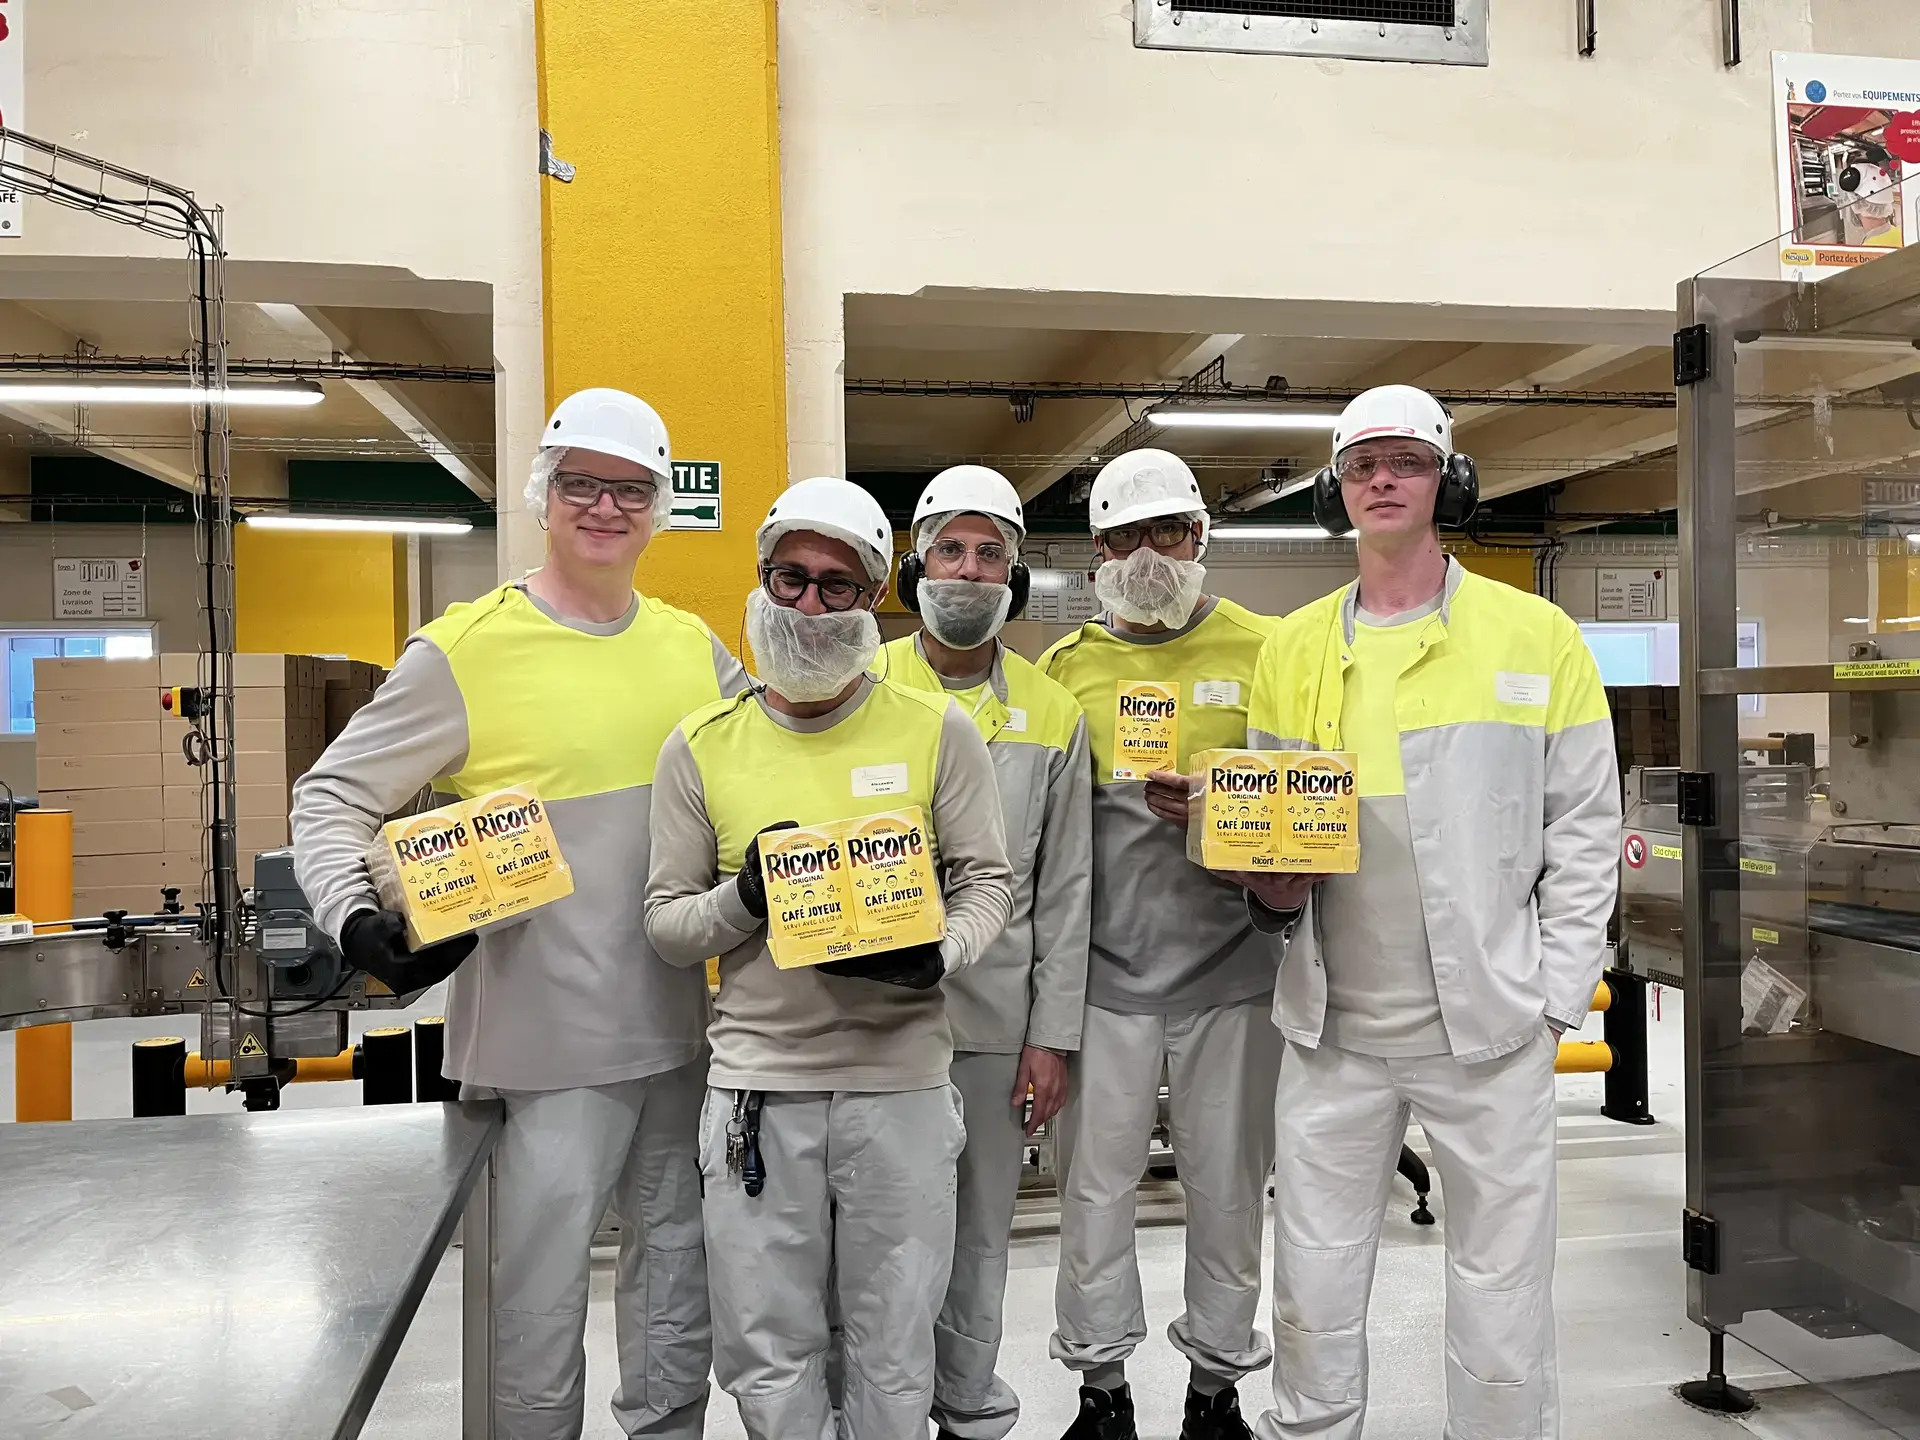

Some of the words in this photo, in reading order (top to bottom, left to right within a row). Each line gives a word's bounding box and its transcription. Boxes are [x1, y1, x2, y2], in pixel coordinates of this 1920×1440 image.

[1833, 90, 1851, 99] Portez
[1863, 90, 1920, 102] EQUIPEMENTS
[1820, 253, 1844, 262] Portez
[1845, 254, 1858, 263] des
[674, 466, 712, 490] TIE
[1120, 696, 1175, 718] Ricoré
[1123, 737, 1141, 747] CAFÉ
[1143, 740, 1168, 748] JOYEUX
[1211, 768, 1277, 794] Ricoré
[1287, 769, 1353, 795] Ricoré
[472, 798, 542, 842] Ricoré
[1217, 817, 1238, 829] CAFÉ
[1240, 820, 1271, 830] JOYEUX
[1293, 819, 1313, 831] CAFÉ
[1316, 823, 1347, 832] JOYEUX
[497, 828, 530, 842] L'ORIGINAL
[394, 821, 469, 866] Ricoré
[848, 827, 922, 868] Ricoré
[1654, 846, 1664, 856] Std
[420, 852, 455, 867] L'ORIGINAL
[496, 857, 518, 875] CAFÉ
[521, 849, 550, 867] JOYEUX
[765, 842, 841, 883] Ricoré
[871, 859, 907, 870] L'ORIGINAL
[1252, 856, 1274, 865] Ricoré
[1742, 860, 1772, 873] relevage
[419, 881, 442, 900] CAFÉ
[444, 874, 476, 892] JOYEUX
[788, 874, 824, 885] L'ORIGINAL
[865, 889, 888, 907] CAFÉ
[469, 908, 493, 923] Ricoré
[782, 904, 805, 922] CAFÉ
[808, 902, 841, 917] JOYEUX
[802, 919, 817, 927] AVEC
[827, 941, 852, 955] Ricoré
